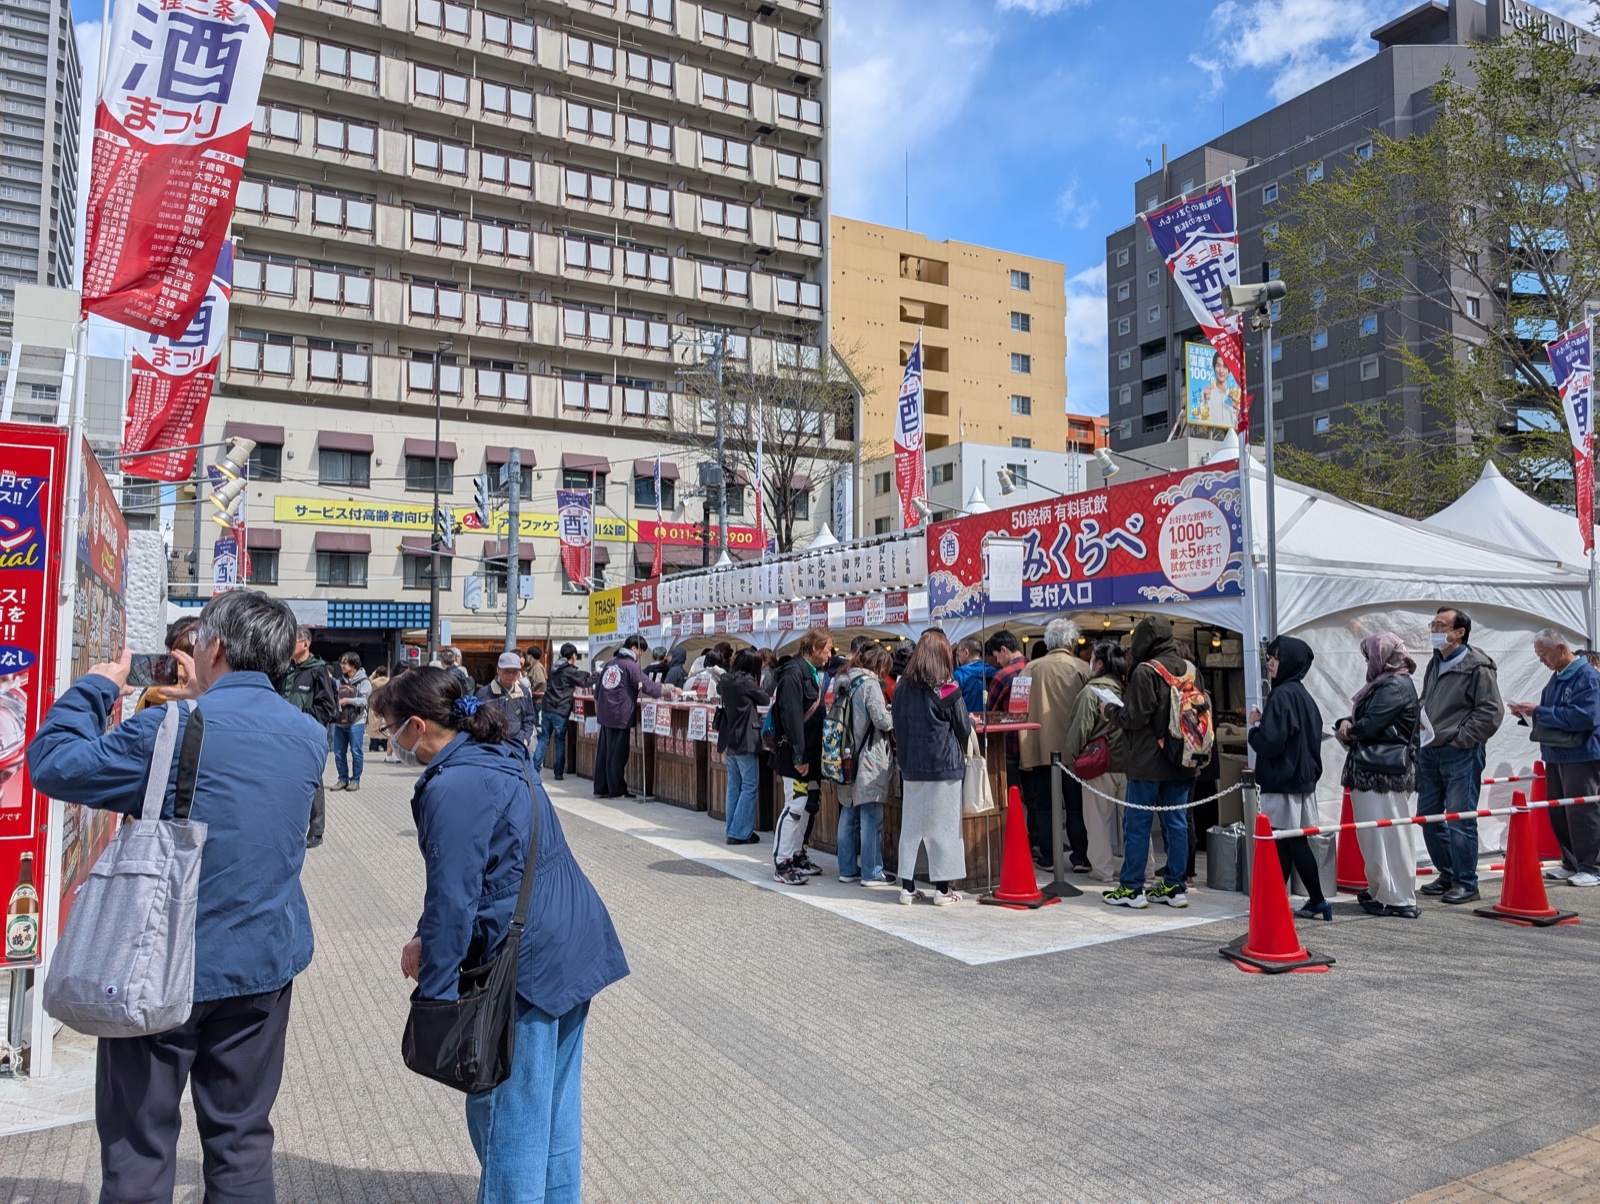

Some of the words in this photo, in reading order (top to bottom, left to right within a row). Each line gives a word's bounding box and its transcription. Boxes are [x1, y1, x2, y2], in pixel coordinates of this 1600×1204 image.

[121, 3, 250, 104] 酒
[124, 96, 222, 138] まつり
[97, 140, 120, 154] 北海道
[197, 160, 225, 174] 千歳鶴
[194, 172, 232, 188] 大雪乃蔵
[191, 182, 230, 199] 国士無双
[105, 201, 130, 213] 岡山県
[189, 193, 218, 207] 北の錦
[102, 209, 129, 220] 広島県
[187, 203, 206, 216] 男山
[101, 217, 127, 228] 山口県
[184, 214, 203, 226] 国稀
[100, 232, 124, 243] 香川県
[182, 225, 200, 237] 福司
[178, 236, 204, 249] 北の勝
[174, 246, 193, 257] 宝川
[170, 256, 189, 267] 金滴
[166, 266, 195, 281] 二世古
[157, 297, 177, 309] 五稜
[152, 346, 205, 368] まつり
[1190, 367, 1214, 381] 100%
[1011, 505, 1052, 530] 50銘柄
[1054, 494, 1108, 522] 有料試飲
[1169, 510, 1213, 525] お好きな銘柄を
[1169, 522, 1221, 545] 1,000円で
[981, 513, 1147, 582] みくらべ
[1170, 542, 1221, 560] 最大5杯まで
[854, 556, 861, 583] 男山
[1170, 557, 1221, 572] 試飲できます!!
[807, 564, 814, 588] 宝川
[818, 557, 826, 590] 北の勝
[1029, 582, 1093, 608] 受付入口
[595, 597, 616, 616] TRASH
[595, 616, 608, 628] Disposal
[0, 650, 29, 667] なし
